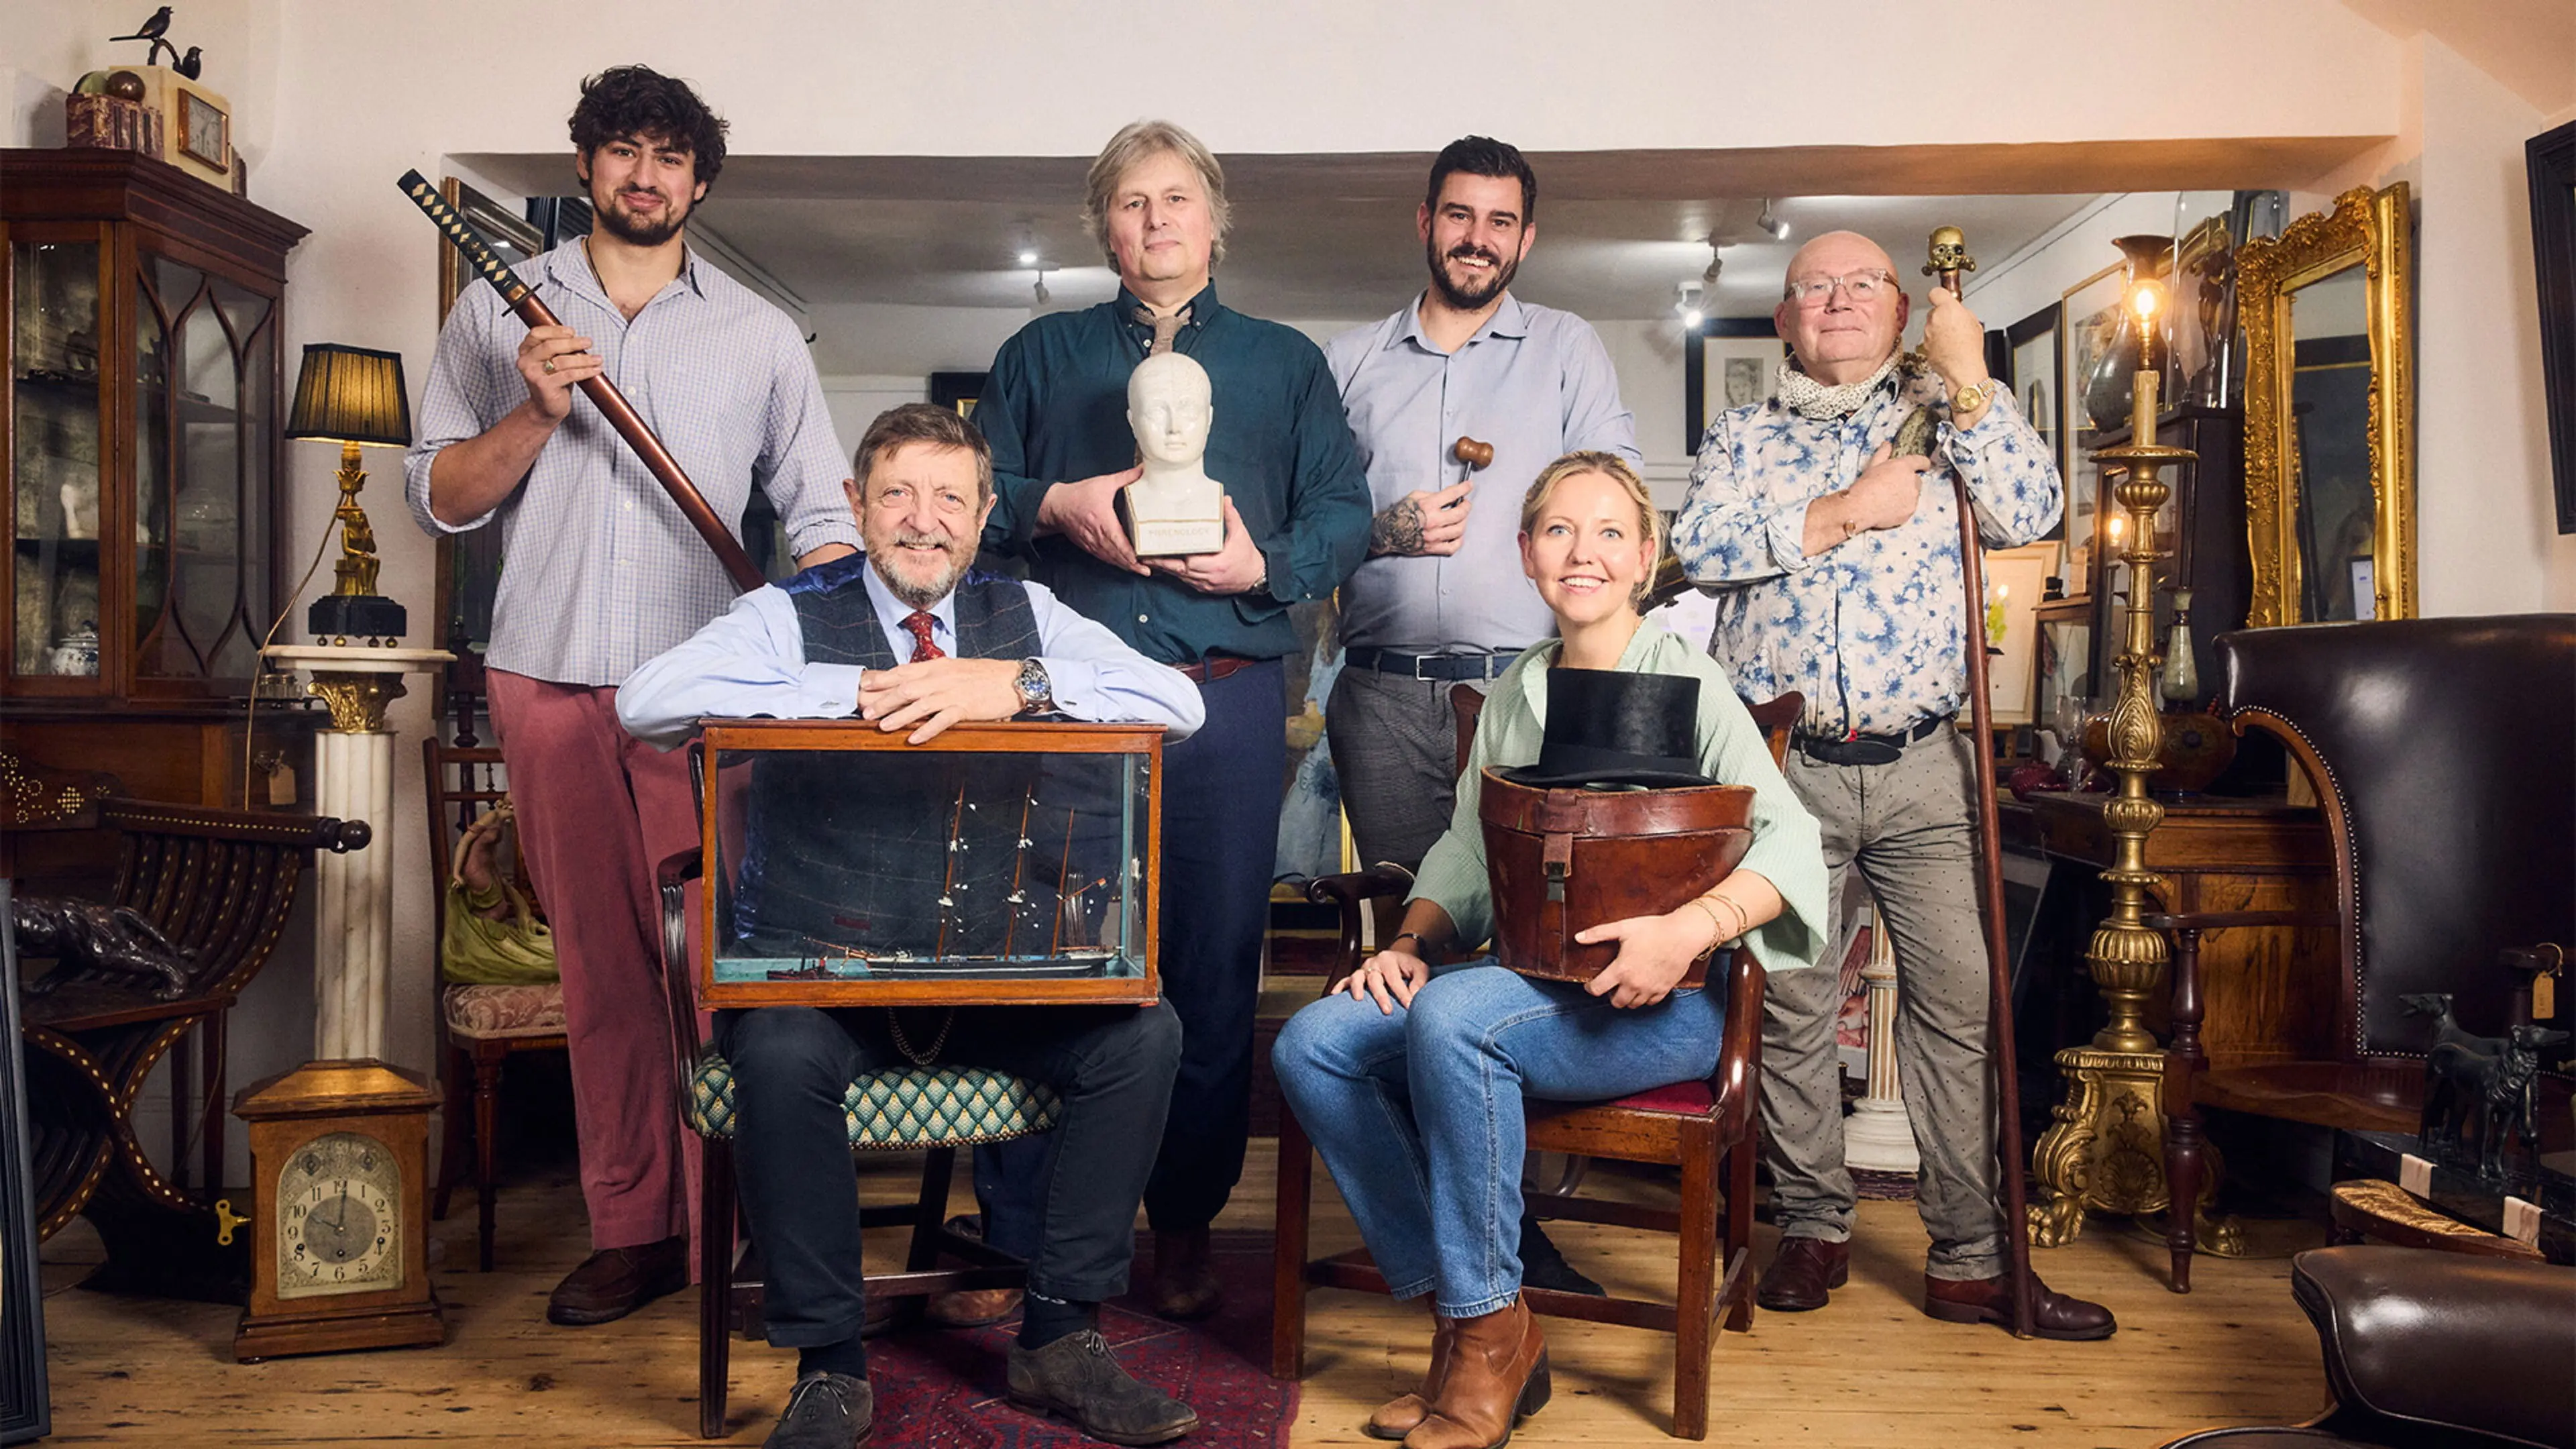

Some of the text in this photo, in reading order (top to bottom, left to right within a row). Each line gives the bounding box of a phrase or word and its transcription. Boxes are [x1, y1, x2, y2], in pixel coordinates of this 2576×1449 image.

[311, 1186, 321, 1201] 11
[333, 1180, 347, 1194] 12
[362, 1185, 365, 1198] 1
[290, 1205, 307, 1219] 10
[374, 1198, 385, 1212] 2
[288, 1226, 299, 1240] 9
[382, 1220, 391, 1234] 3
[310, 1261, 320, 1278] 7
[358, 1258, 368, 1273] 5
[334, 1267, 344, 1281] 6
